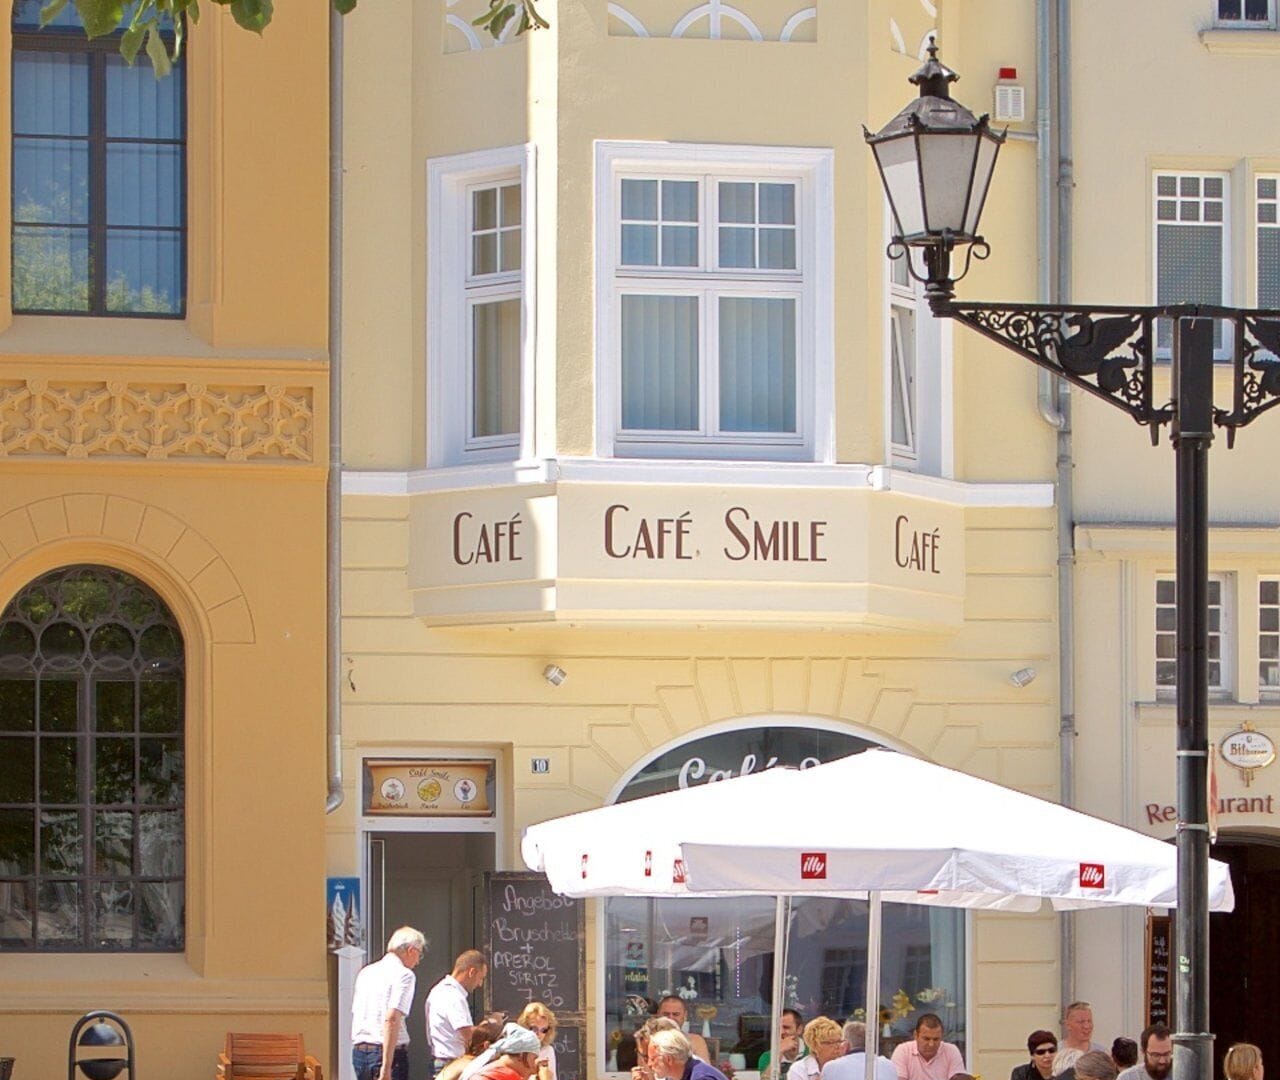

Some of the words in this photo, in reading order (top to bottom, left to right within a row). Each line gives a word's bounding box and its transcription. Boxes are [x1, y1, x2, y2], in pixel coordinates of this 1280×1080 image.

[535, 759, 547, 772] 10
[803, 856, 825, 877] illy
[1081, 866, 1103, 885] illy
[493, 951, 555, 971] APEROL
[509, 970, 559, 987] SPRITZ
